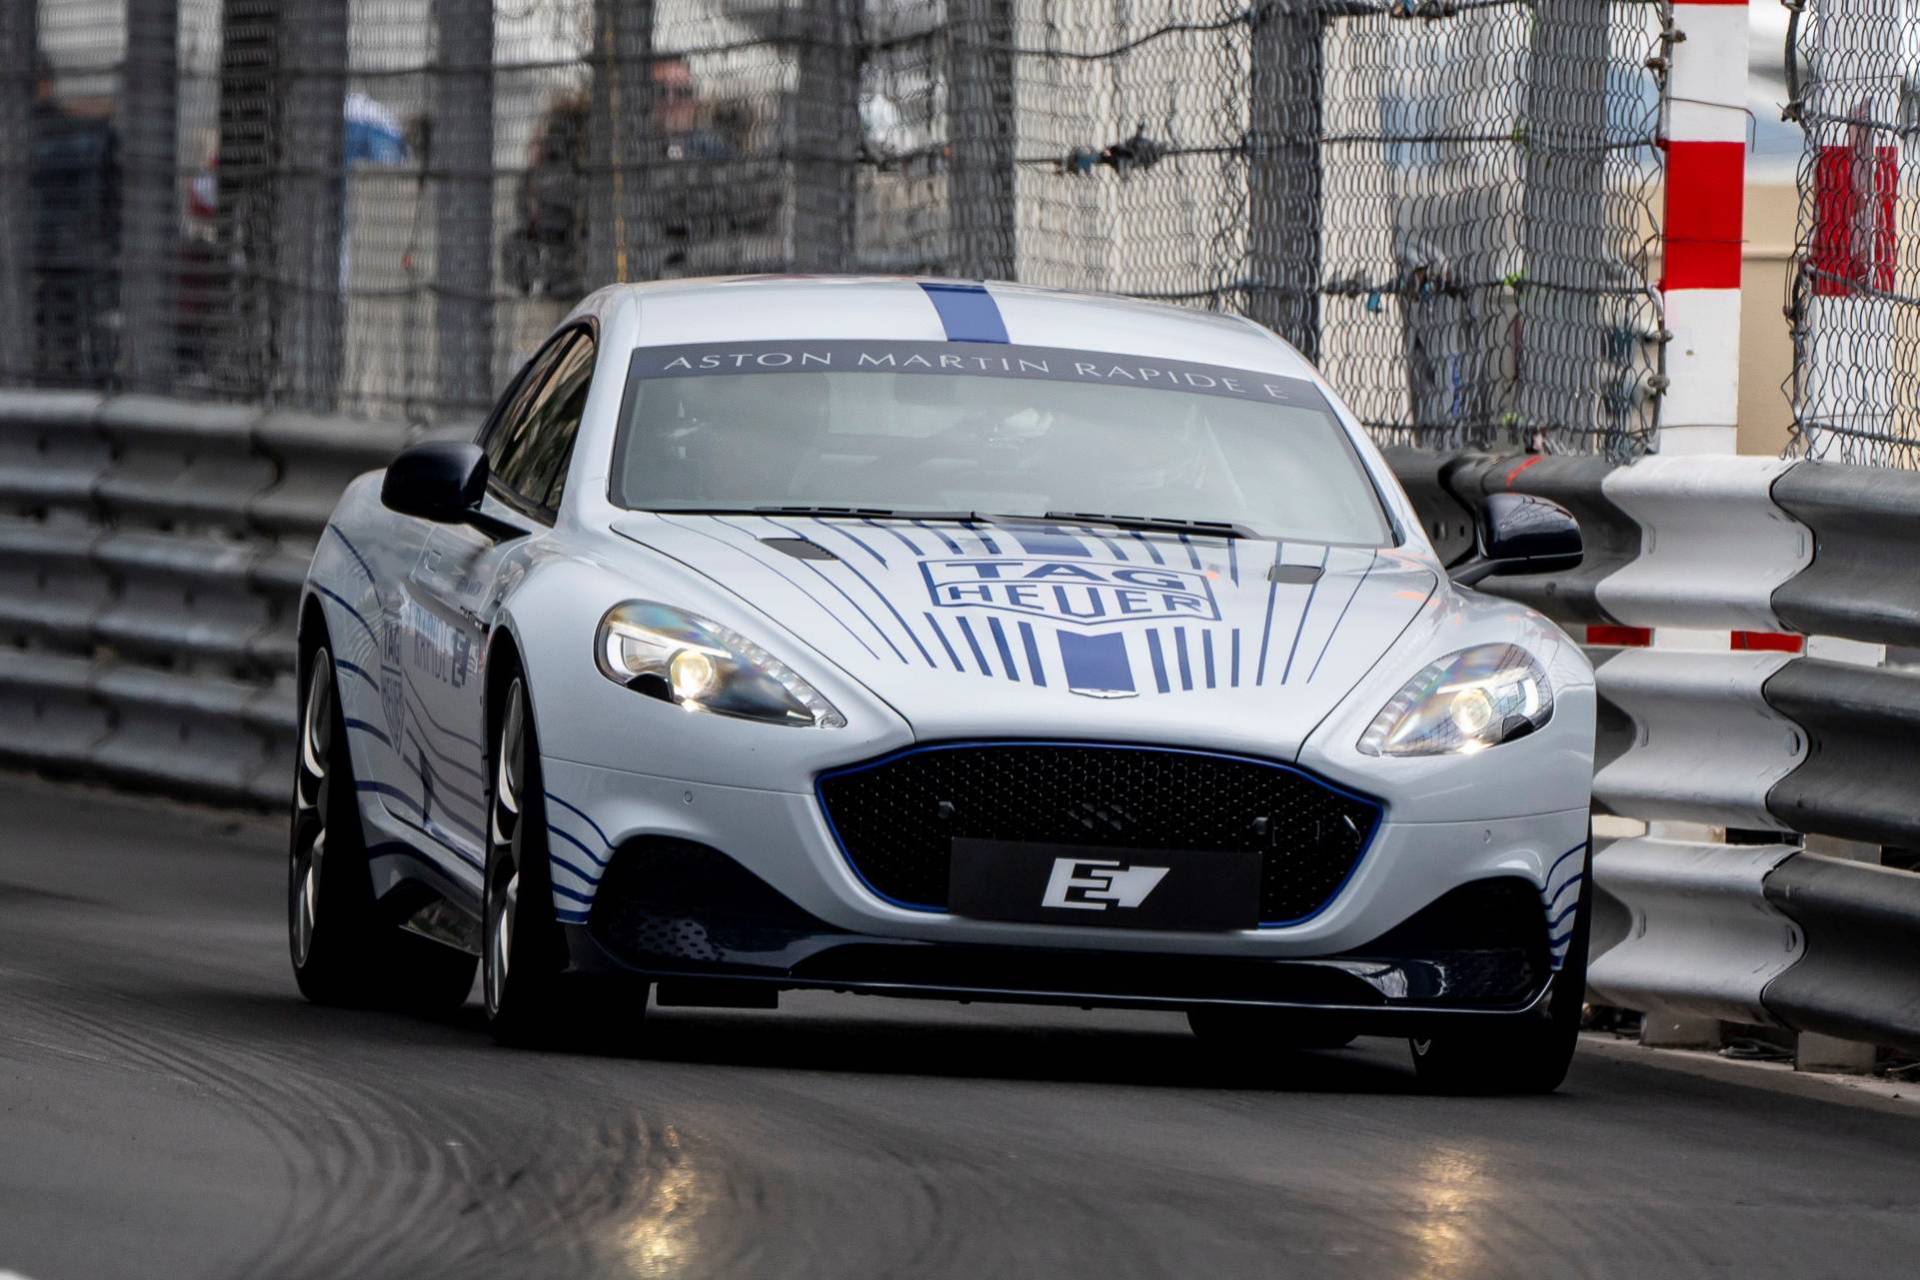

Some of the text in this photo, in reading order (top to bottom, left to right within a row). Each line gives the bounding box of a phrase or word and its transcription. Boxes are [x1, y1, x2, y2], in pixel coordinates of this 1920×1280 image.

[663, 352, 1289, 399] ASTON MARTIN RAPIDE E
[945, 562, 1187, 590] TAG
[948, 585, 1202, 618] HEUER
[384, 621, 400, 667] TAG
